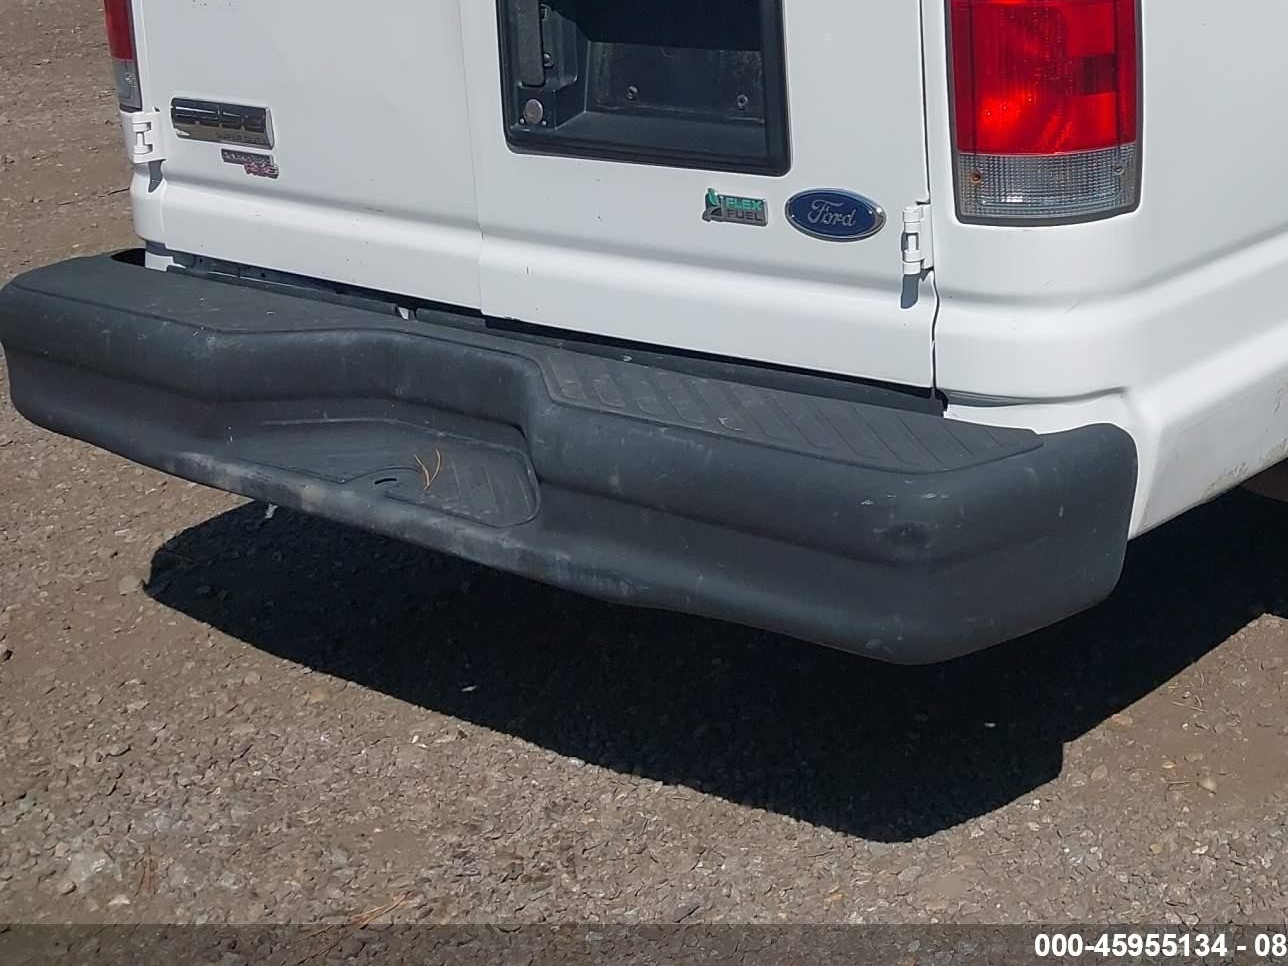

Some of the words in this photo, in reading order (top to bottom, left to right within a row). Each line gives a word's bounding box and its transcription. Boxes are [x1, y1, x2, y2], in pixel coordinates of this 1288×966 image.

[725, 197, 763, 211] FLEX
[726, 209, 763, 221] FUEL
[807, 199, 857, 227] Ford
